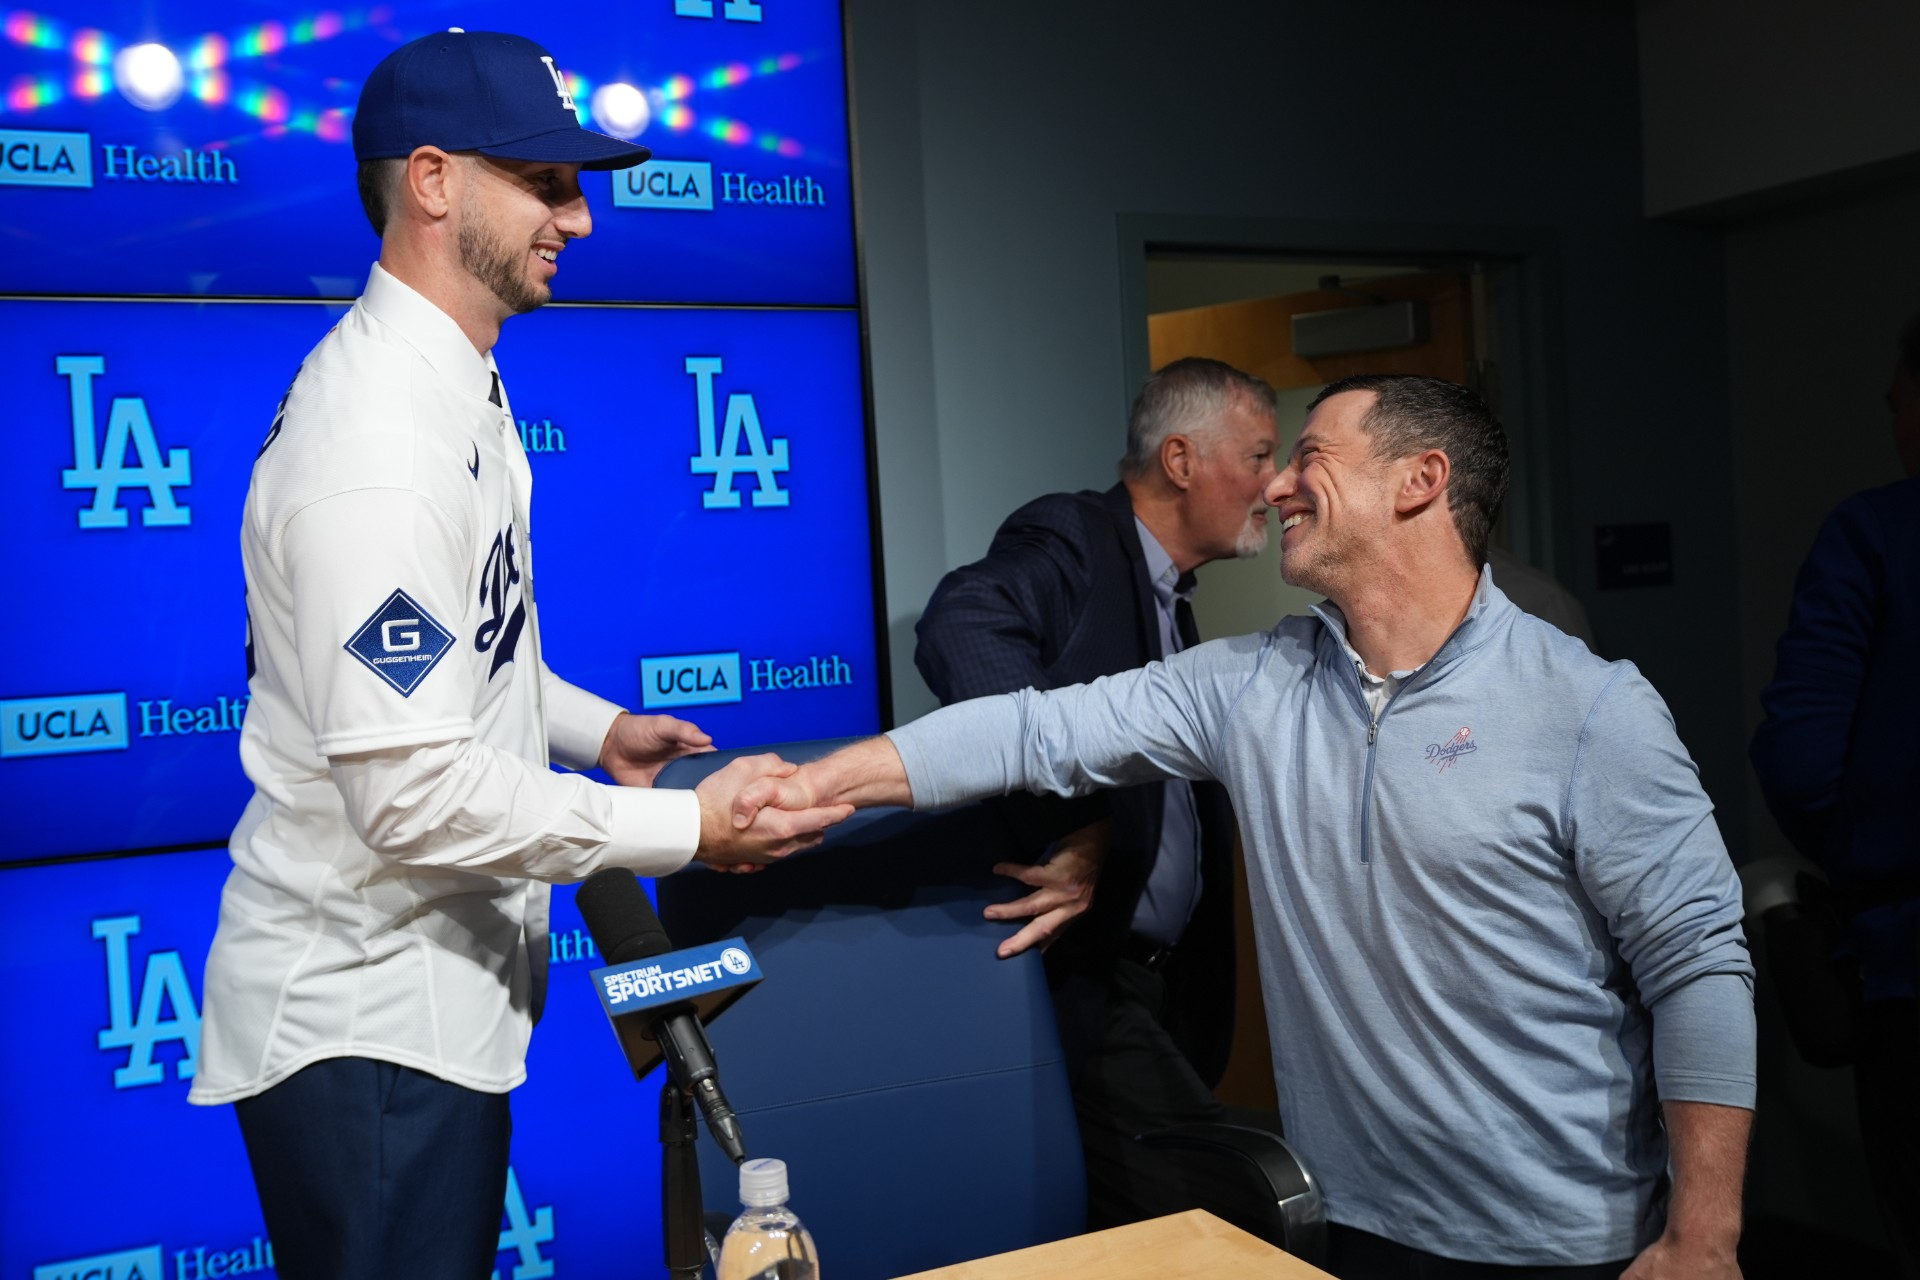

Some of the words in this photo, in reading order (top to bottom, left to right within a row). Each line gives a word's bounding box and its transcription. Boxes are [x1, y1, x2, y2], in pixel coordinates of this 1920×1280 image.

[0, 142, 75, 174] CLA
[102, 144, 239, 183] Health
[626, 170, 700, 199] UCLA
[721, 171, 825, 207] Health
[56, 356, 192, 529] LA
[518, 419, 567, 453] lth
[685, 357, 790, 509] LA
[381, 618, 421, 653] G
[372, 654, 433, 665] GUGGENHEIM
[657, 666, 728, 695] UCLA
[749, 655, 852, 692] Health
[18, 707, 111, 741] UCLA
[137, 695, 252, 738] Healt
[1424, 740, 1478, 761] Dodgers
[549, 928, 596, 966] lth
[603, 964, 663, 988] SPECTRUM
[606, 960, 724, 1005] SPORTSNET
[92, 915, 202, 1090] LA
[175, 1235, 275, 1280] Heal
